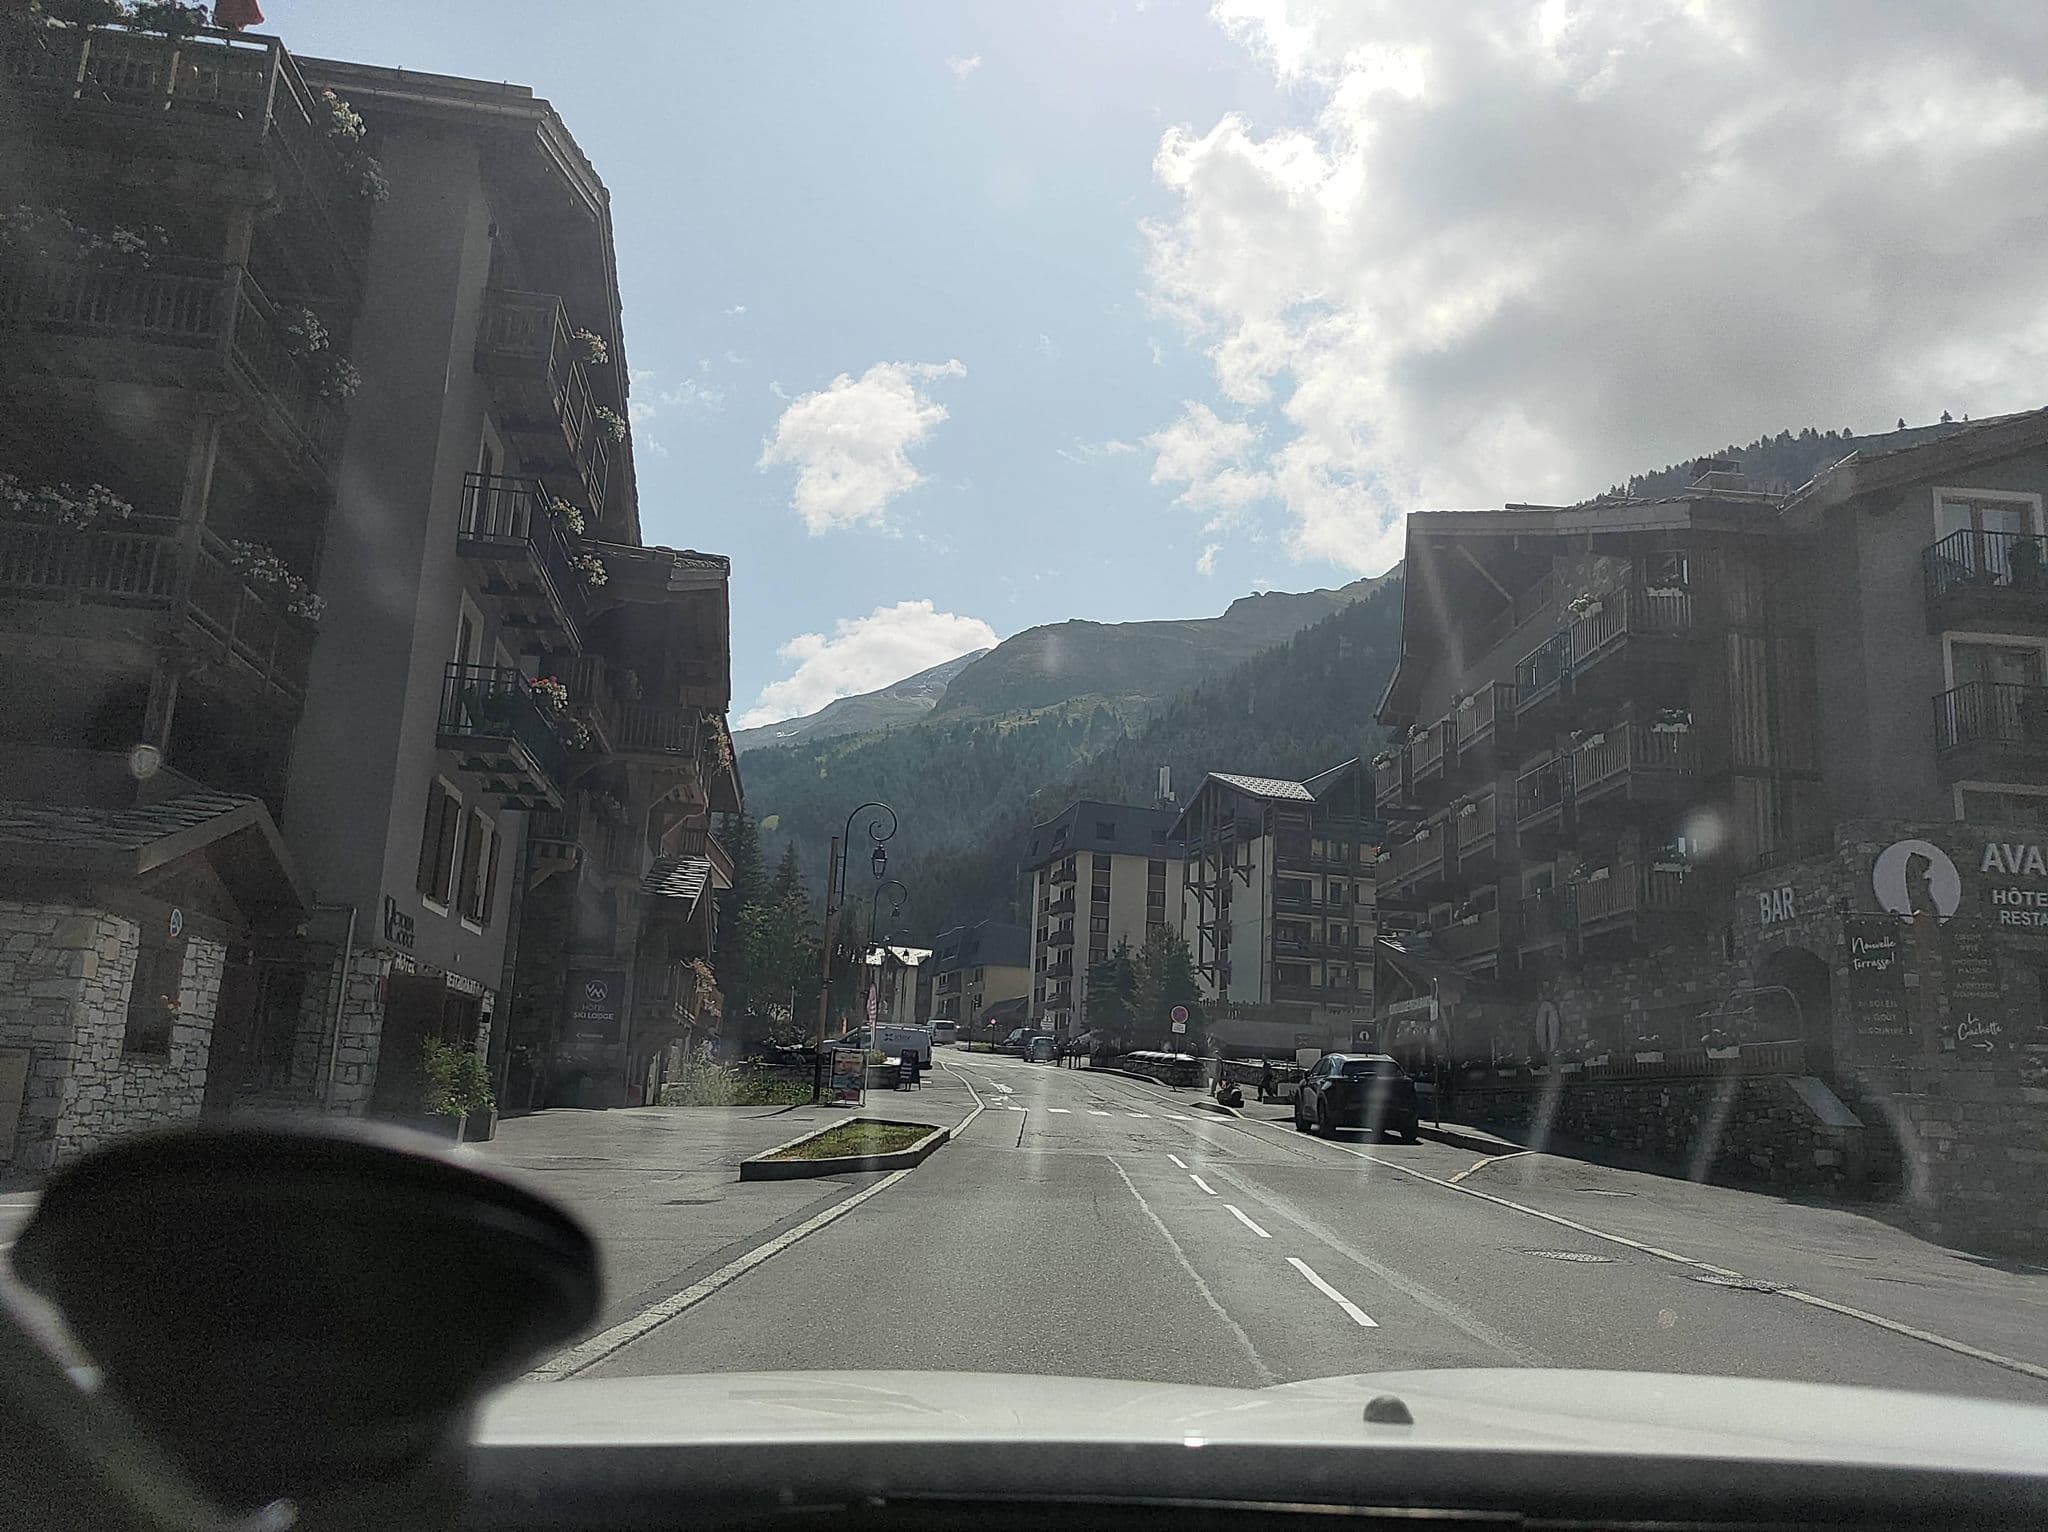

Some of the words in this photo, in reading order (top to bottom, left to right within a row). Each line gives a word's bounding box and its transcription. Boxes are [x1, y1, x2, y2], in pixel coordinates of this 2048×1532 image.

[1760, 887, 1795, 924] BAR
[573, 1011, 587, 1019] SKI
[588, 1012, 615, 1020] LODGE
